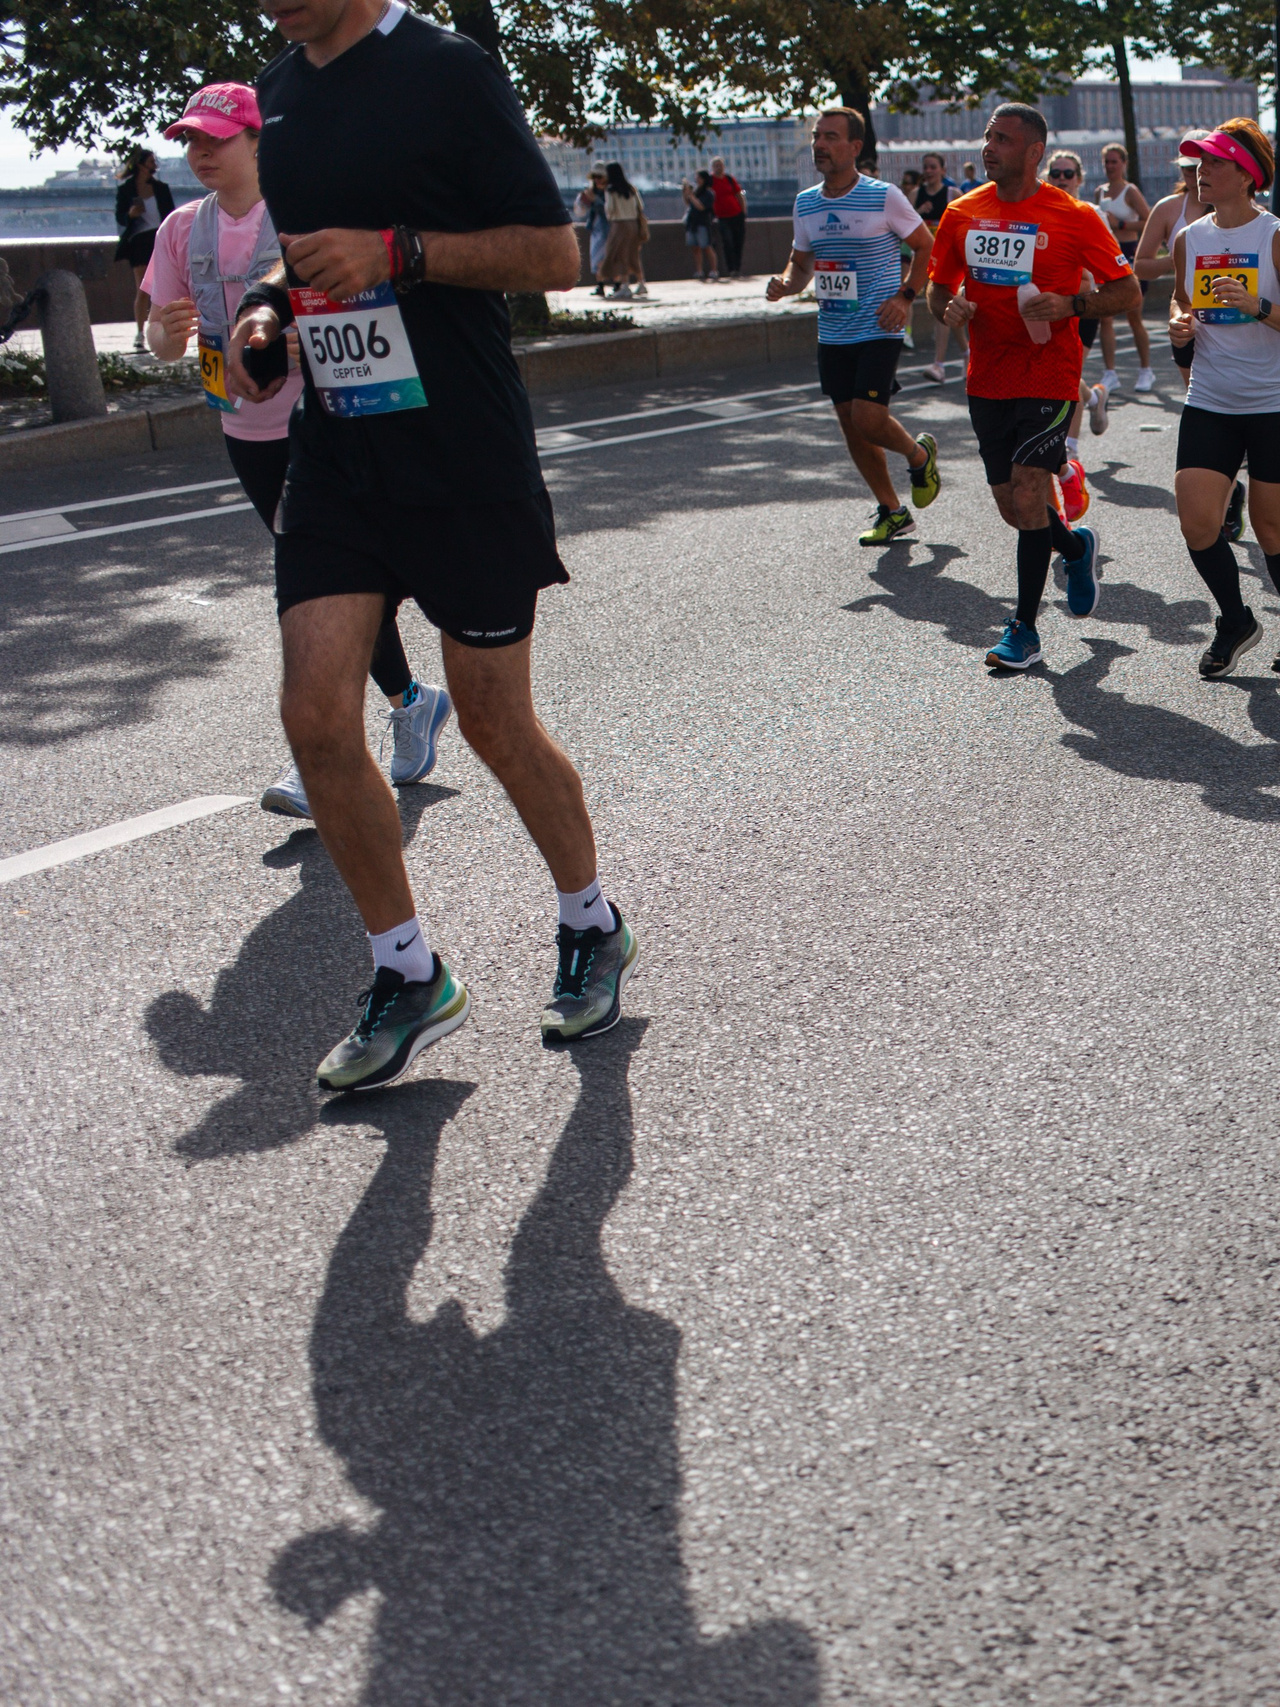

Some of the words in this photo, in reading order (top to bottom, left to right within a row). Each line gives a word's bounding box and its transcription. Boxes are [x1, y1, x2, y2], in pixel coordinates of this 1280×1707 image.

[201, 93, 238, 116] YORK
[974, 235, 1025, 259] 3819
[978, 257, 1018, 267] АЛЕКСАНДР
[971, 268, 979, 279] E
[819, 275, 850, 291] 3149
[1197, 310, 1206, 322] E
[308, 320, 391, 365] 5006
[333, 363, 372, 379] СЕРГЕЙ
[323, 391, 335, 412] E
[1038, 431, 1066, 455] SPORT
